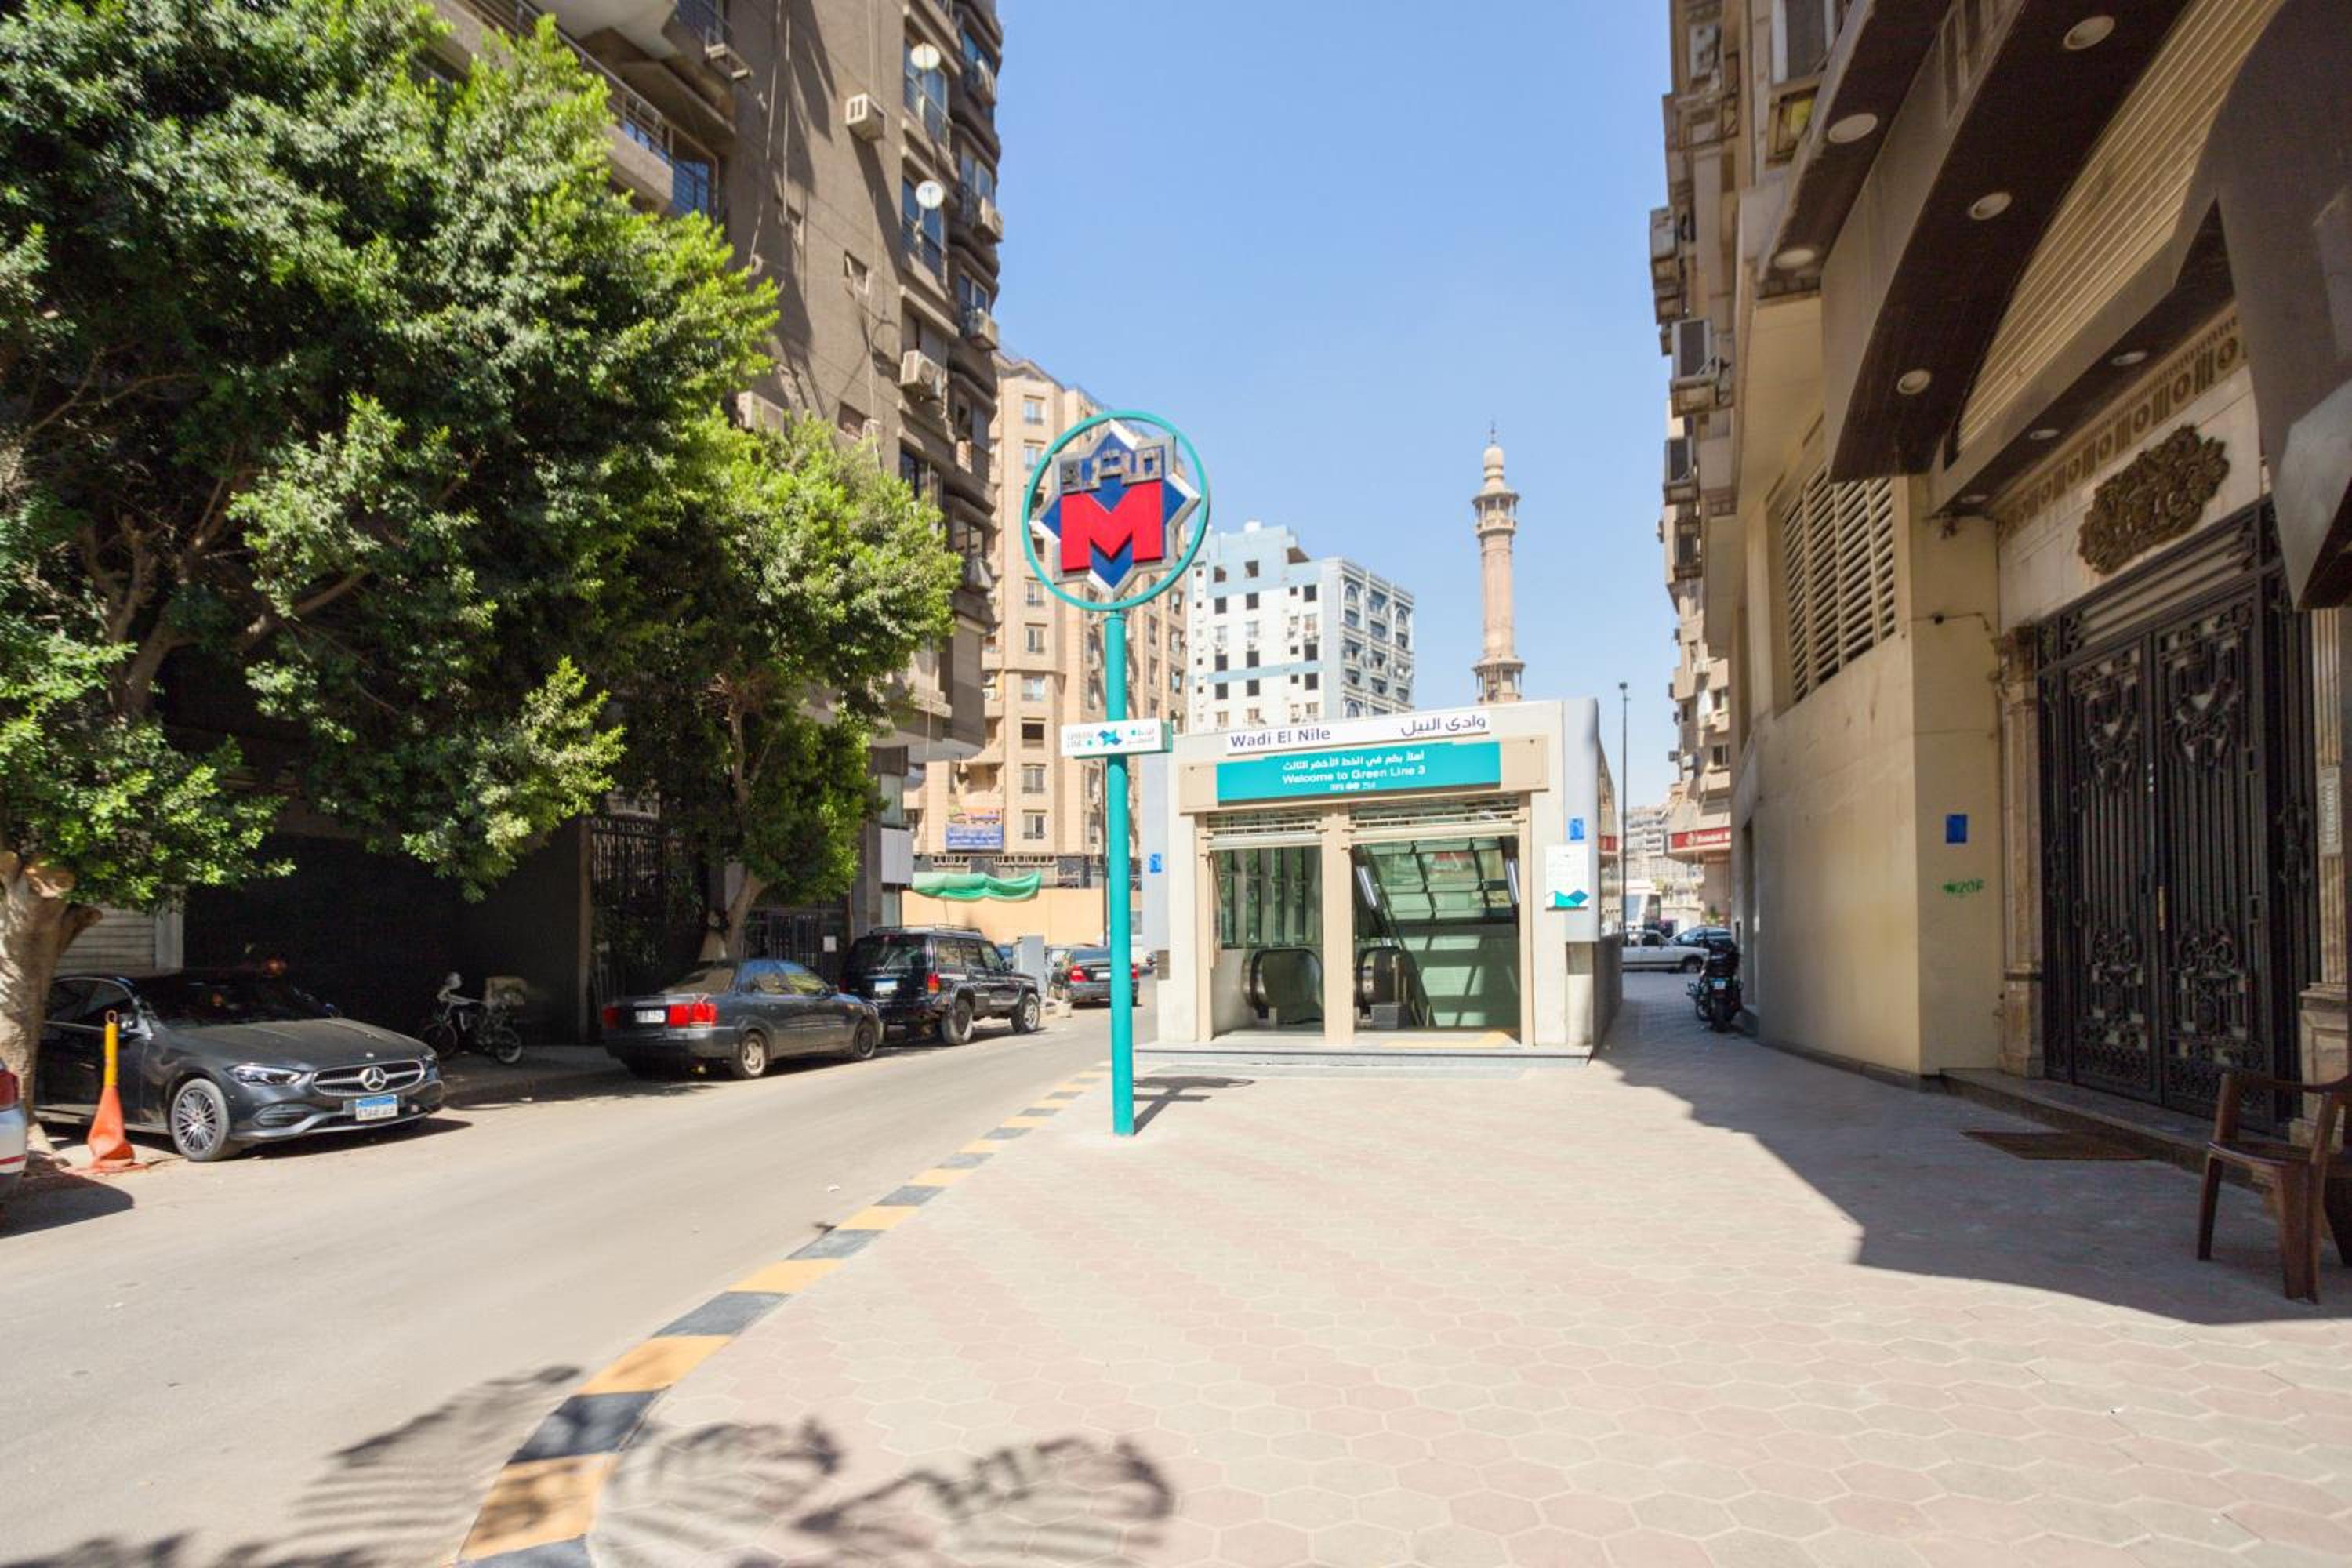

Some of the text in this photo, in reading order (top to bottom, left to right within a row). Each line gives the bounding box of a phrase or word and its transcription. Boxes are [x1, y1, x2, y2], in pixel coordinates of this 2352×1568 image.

[1060, 480, 1163, 576] M
[1229, 727, 1330, 747] Wadi El Nile
[1401, 717, 1441, 737] النيل
[1341, 755, 1364, 767] الخط
[1282, 764, 1426, 785] Welcome to Green Line 3
